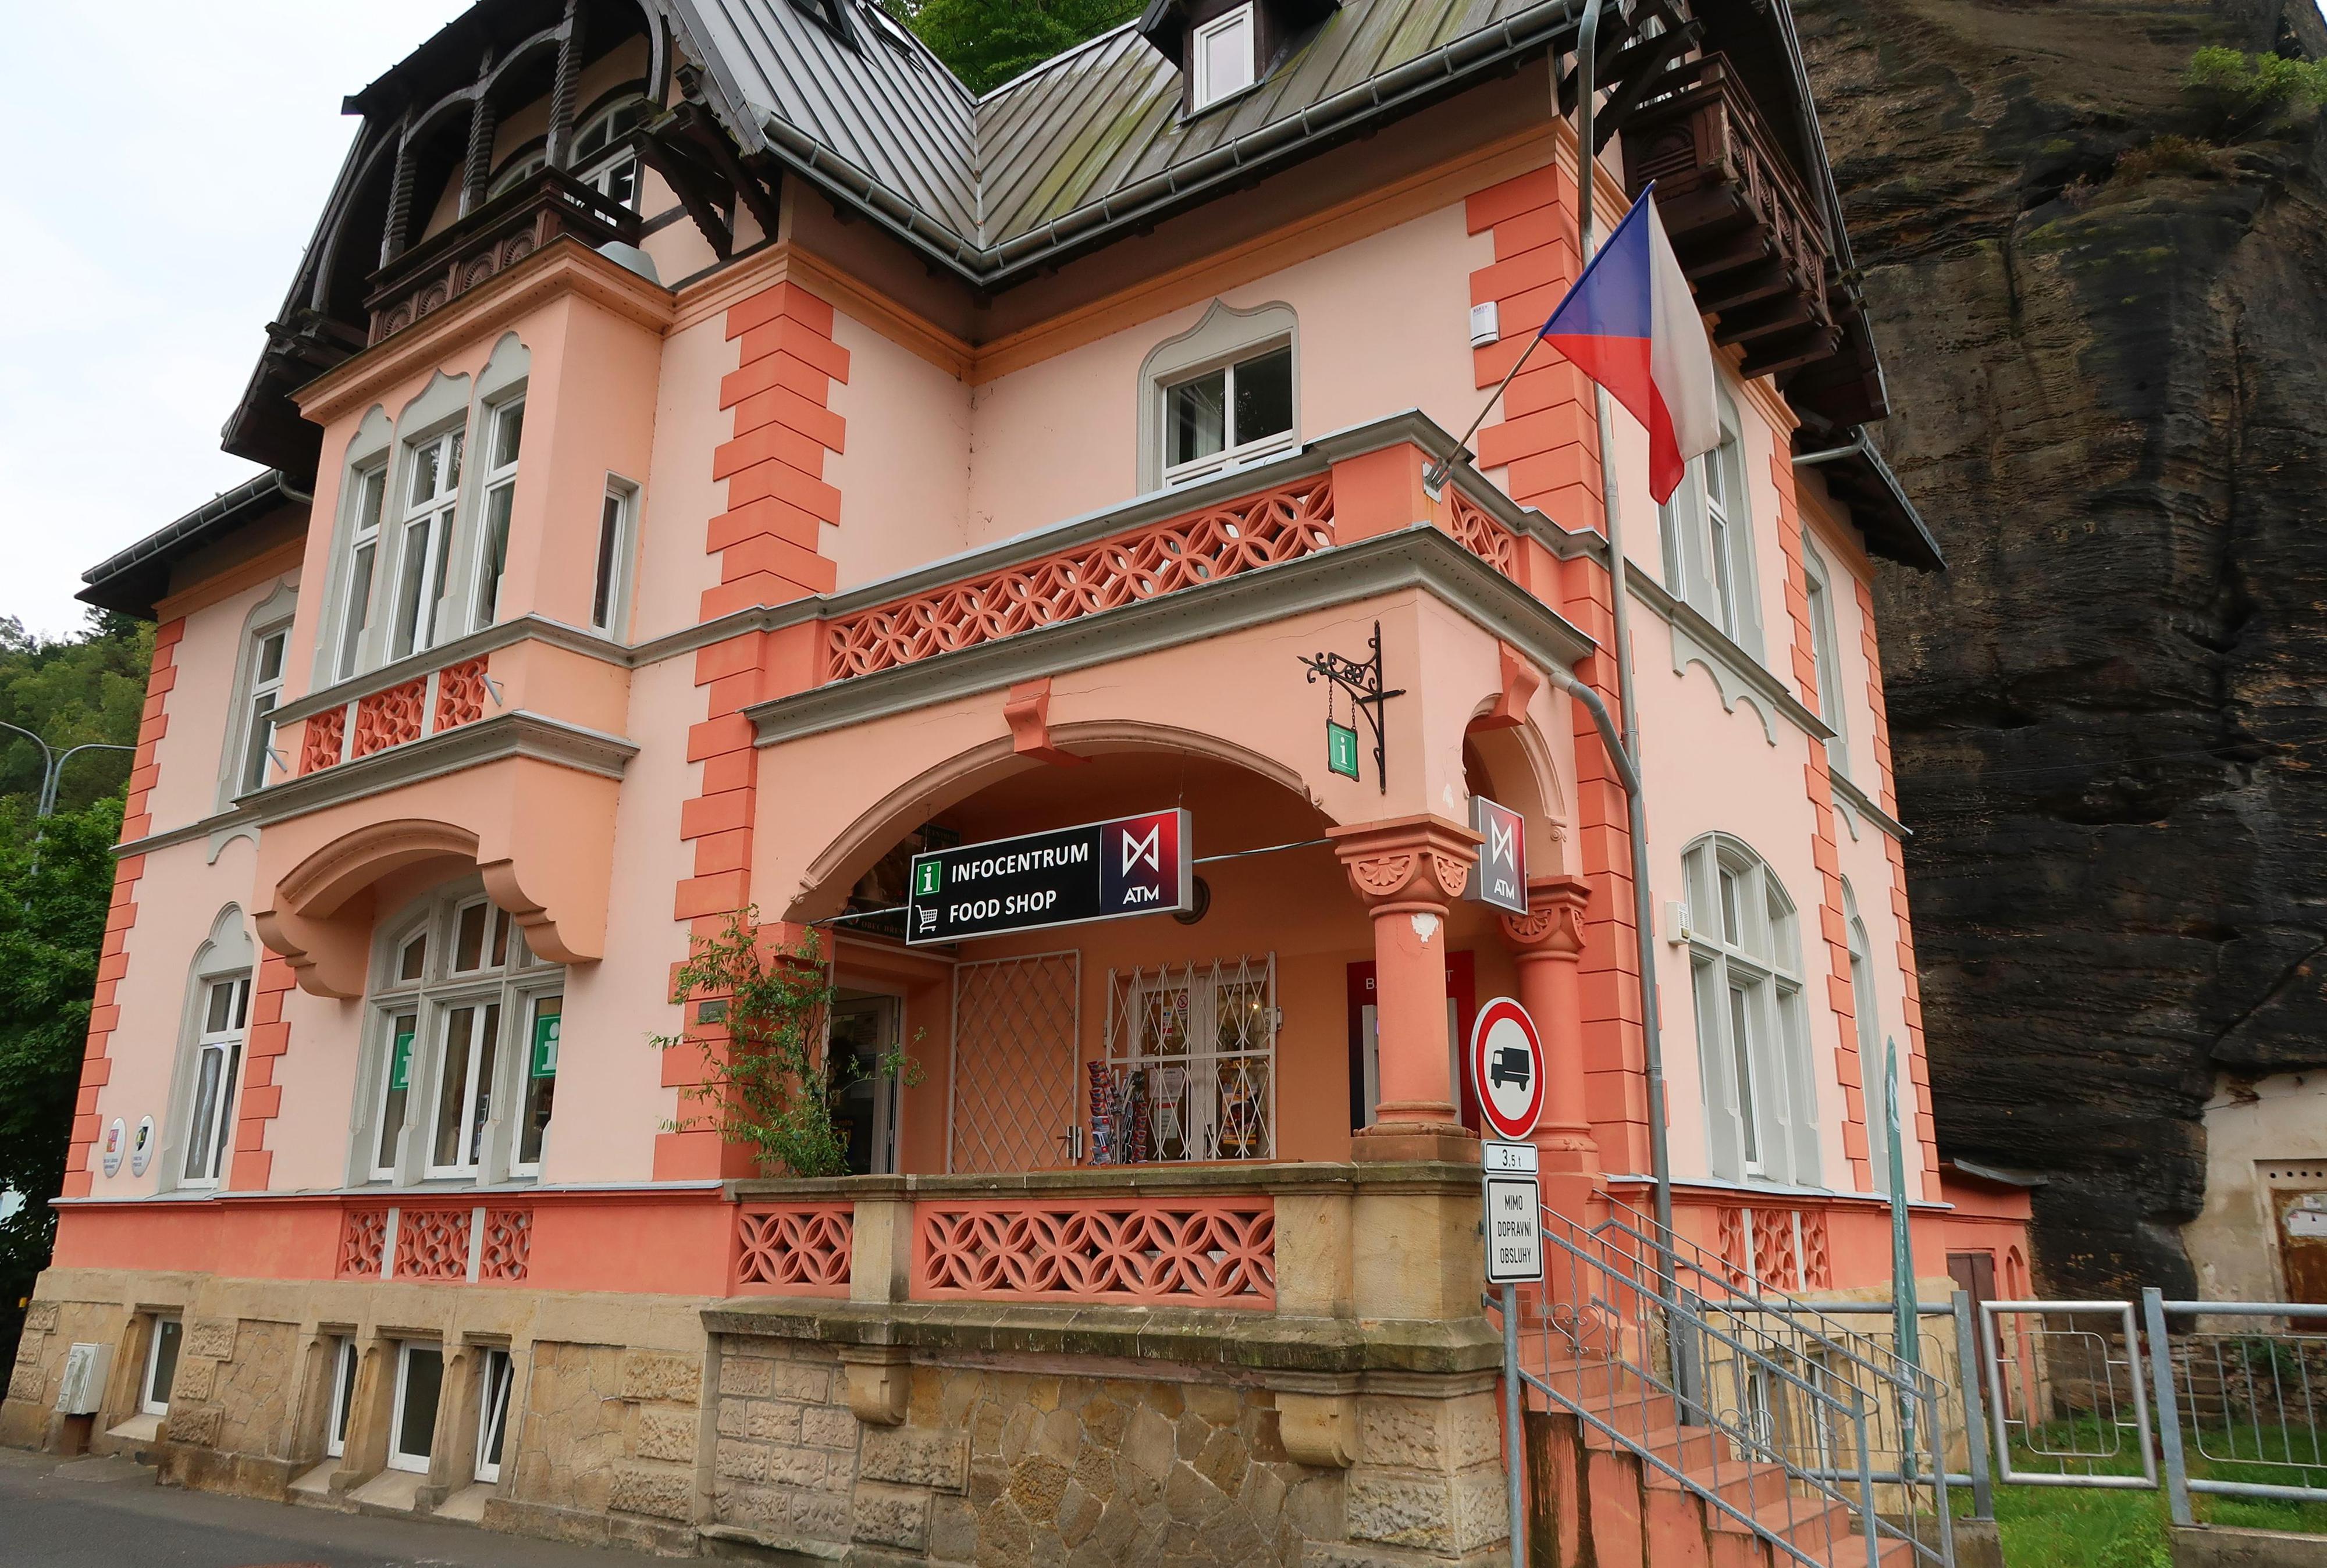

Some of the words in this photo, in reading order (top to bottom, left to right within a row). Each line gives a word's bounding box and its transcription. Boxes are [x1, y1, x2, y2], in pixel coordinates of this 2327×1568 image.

[952, 843, 1088, 883] INFOCENTRUM
[1123, 883, 1159, 904] ATM
[1494, 878, 1515, 900] ATM
[949, 899, 1000, 923] FOOD
[1005, 890, 1056, 915] SHOP
[1502, 1149, 1515, 1168] 3,5
[1518, 1156, 1521, 1167] t
[1504, 1195, 1523, 1210] MIMO
[1497, 1218, 1532, 1237] DOPRAVNÍ
[1500, 1248, 1532, 1264] OBSLUHY
